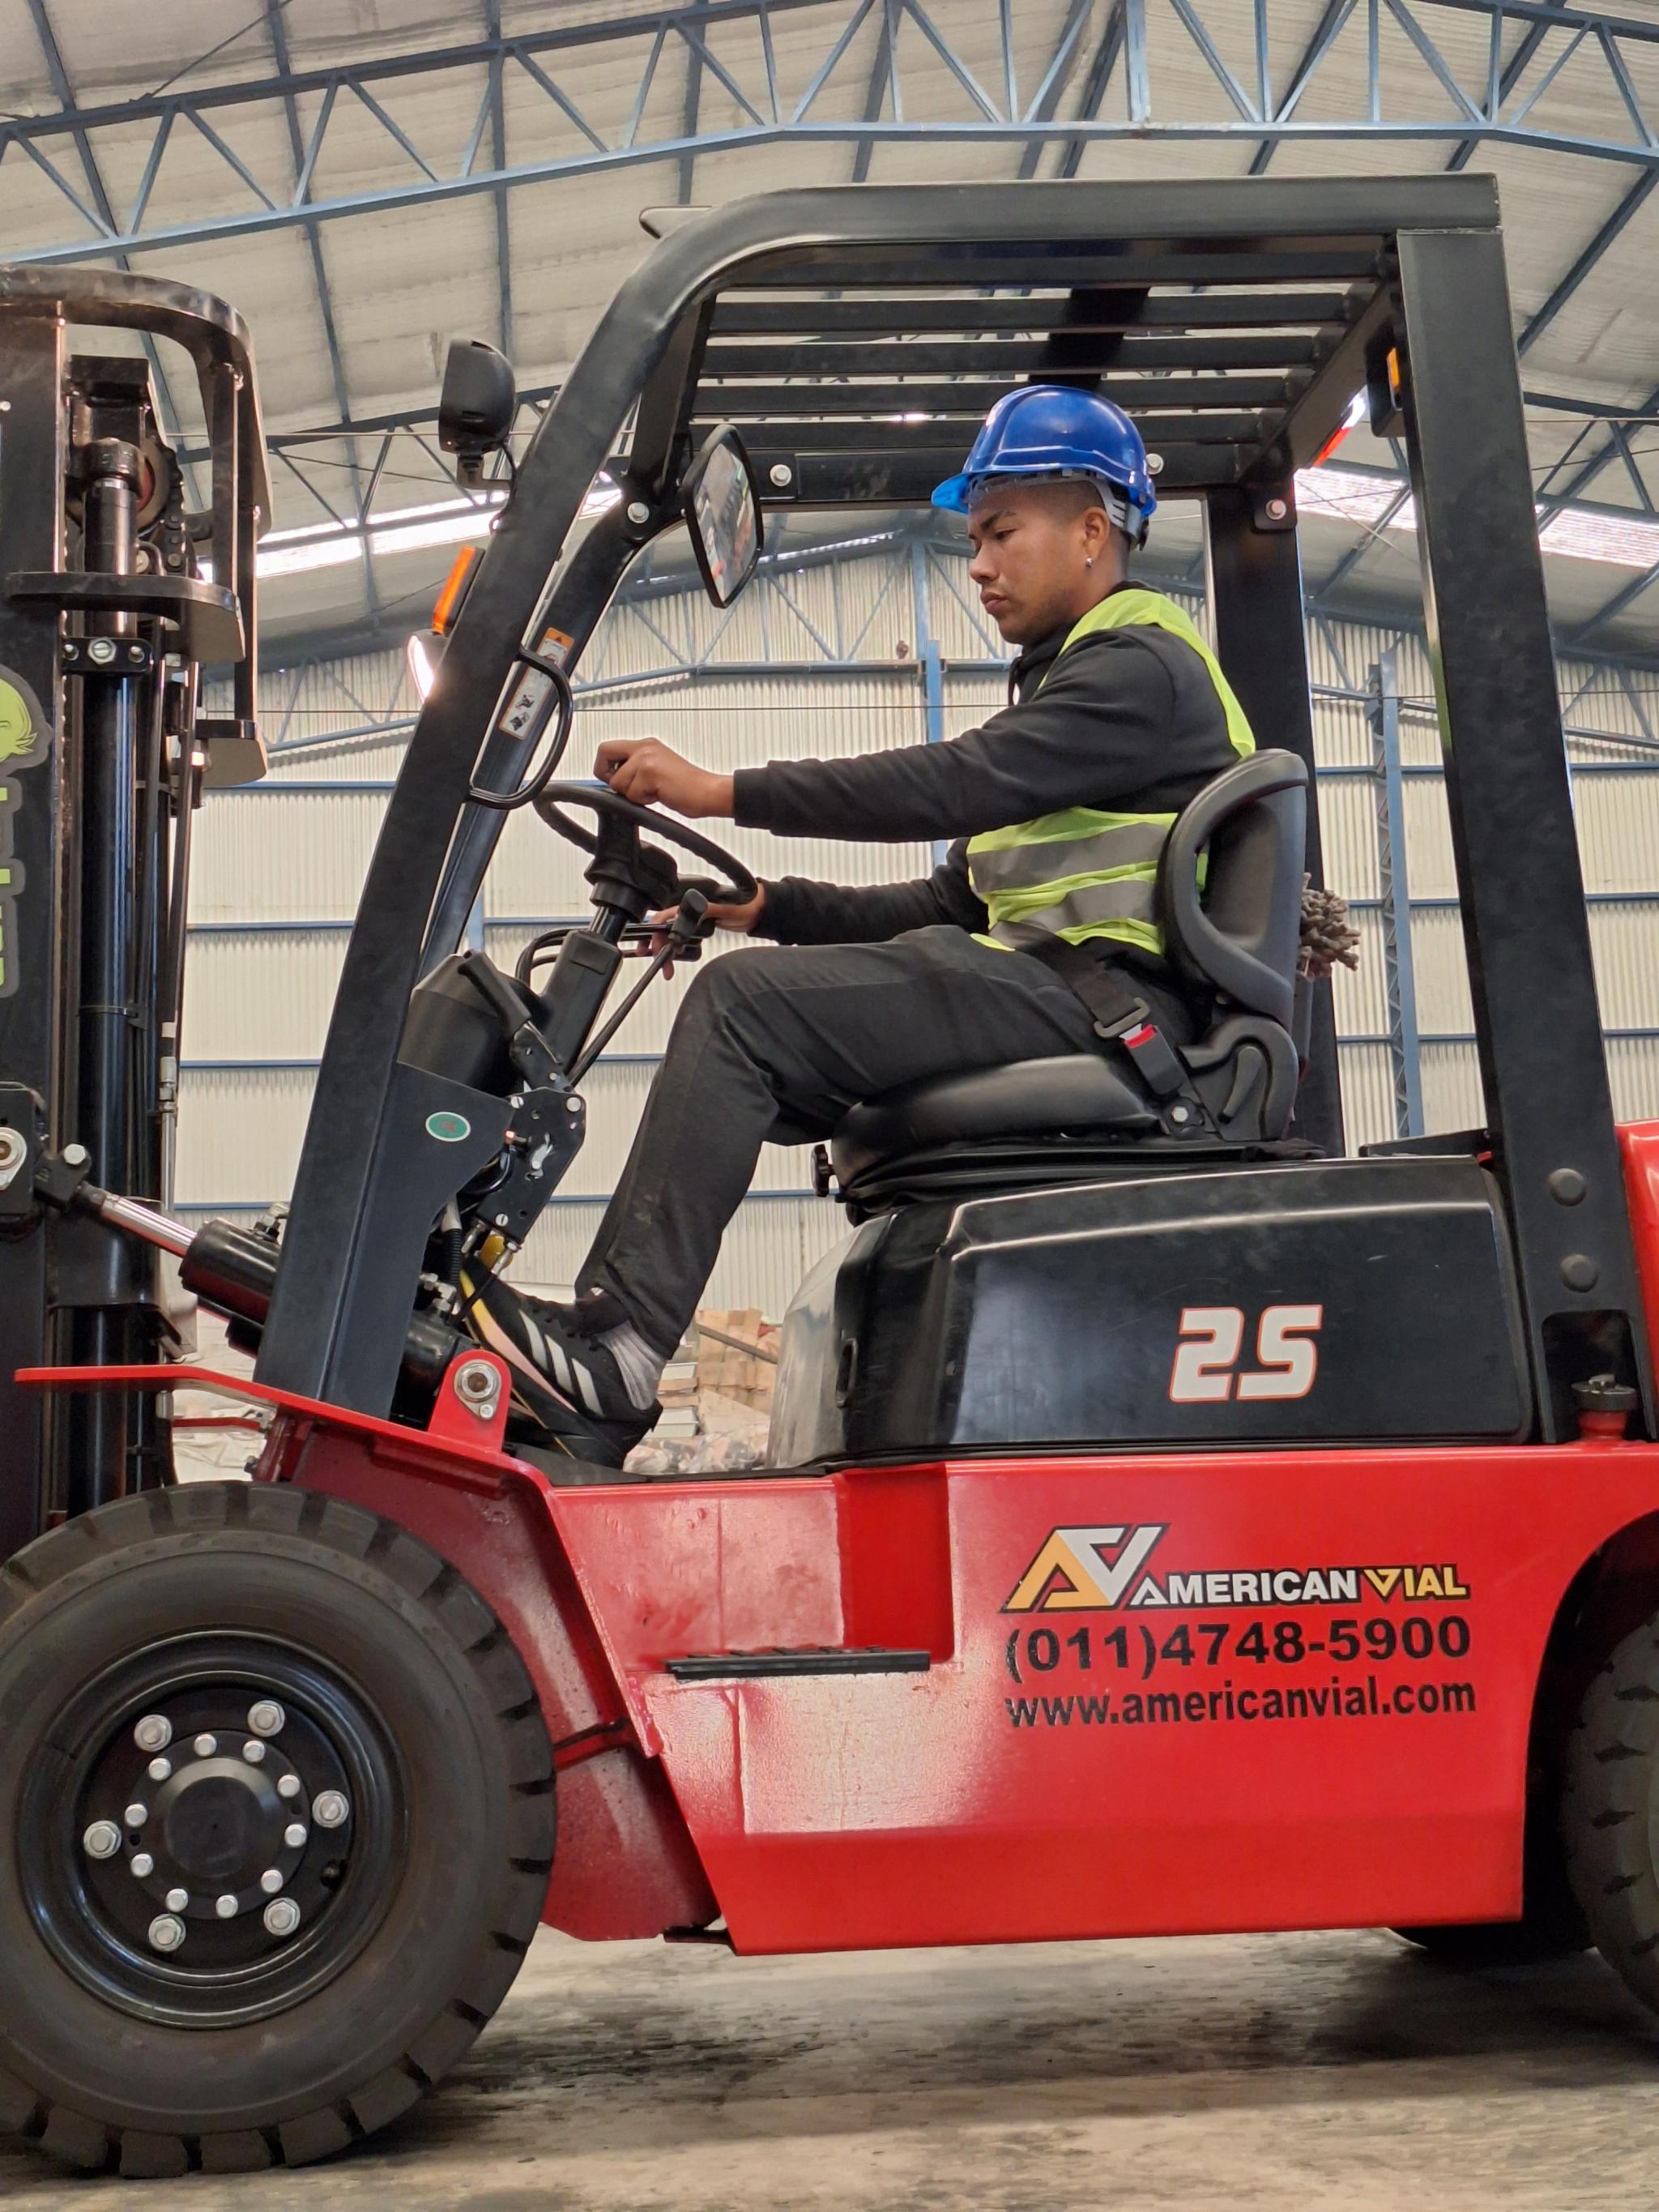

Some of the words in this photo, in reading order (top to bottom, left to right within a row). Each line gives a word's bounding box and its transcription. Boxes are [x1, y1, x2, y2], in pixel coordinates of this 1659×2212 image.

[1128, 1568, 1358, 1607] AMERICAN
[1363, 1565, 1468, 1599] VIAL
[1005, 1616, 1471, 1684] (011)4748-5900
[1005, 1676, 1476, 1727] www.americanvial.com
